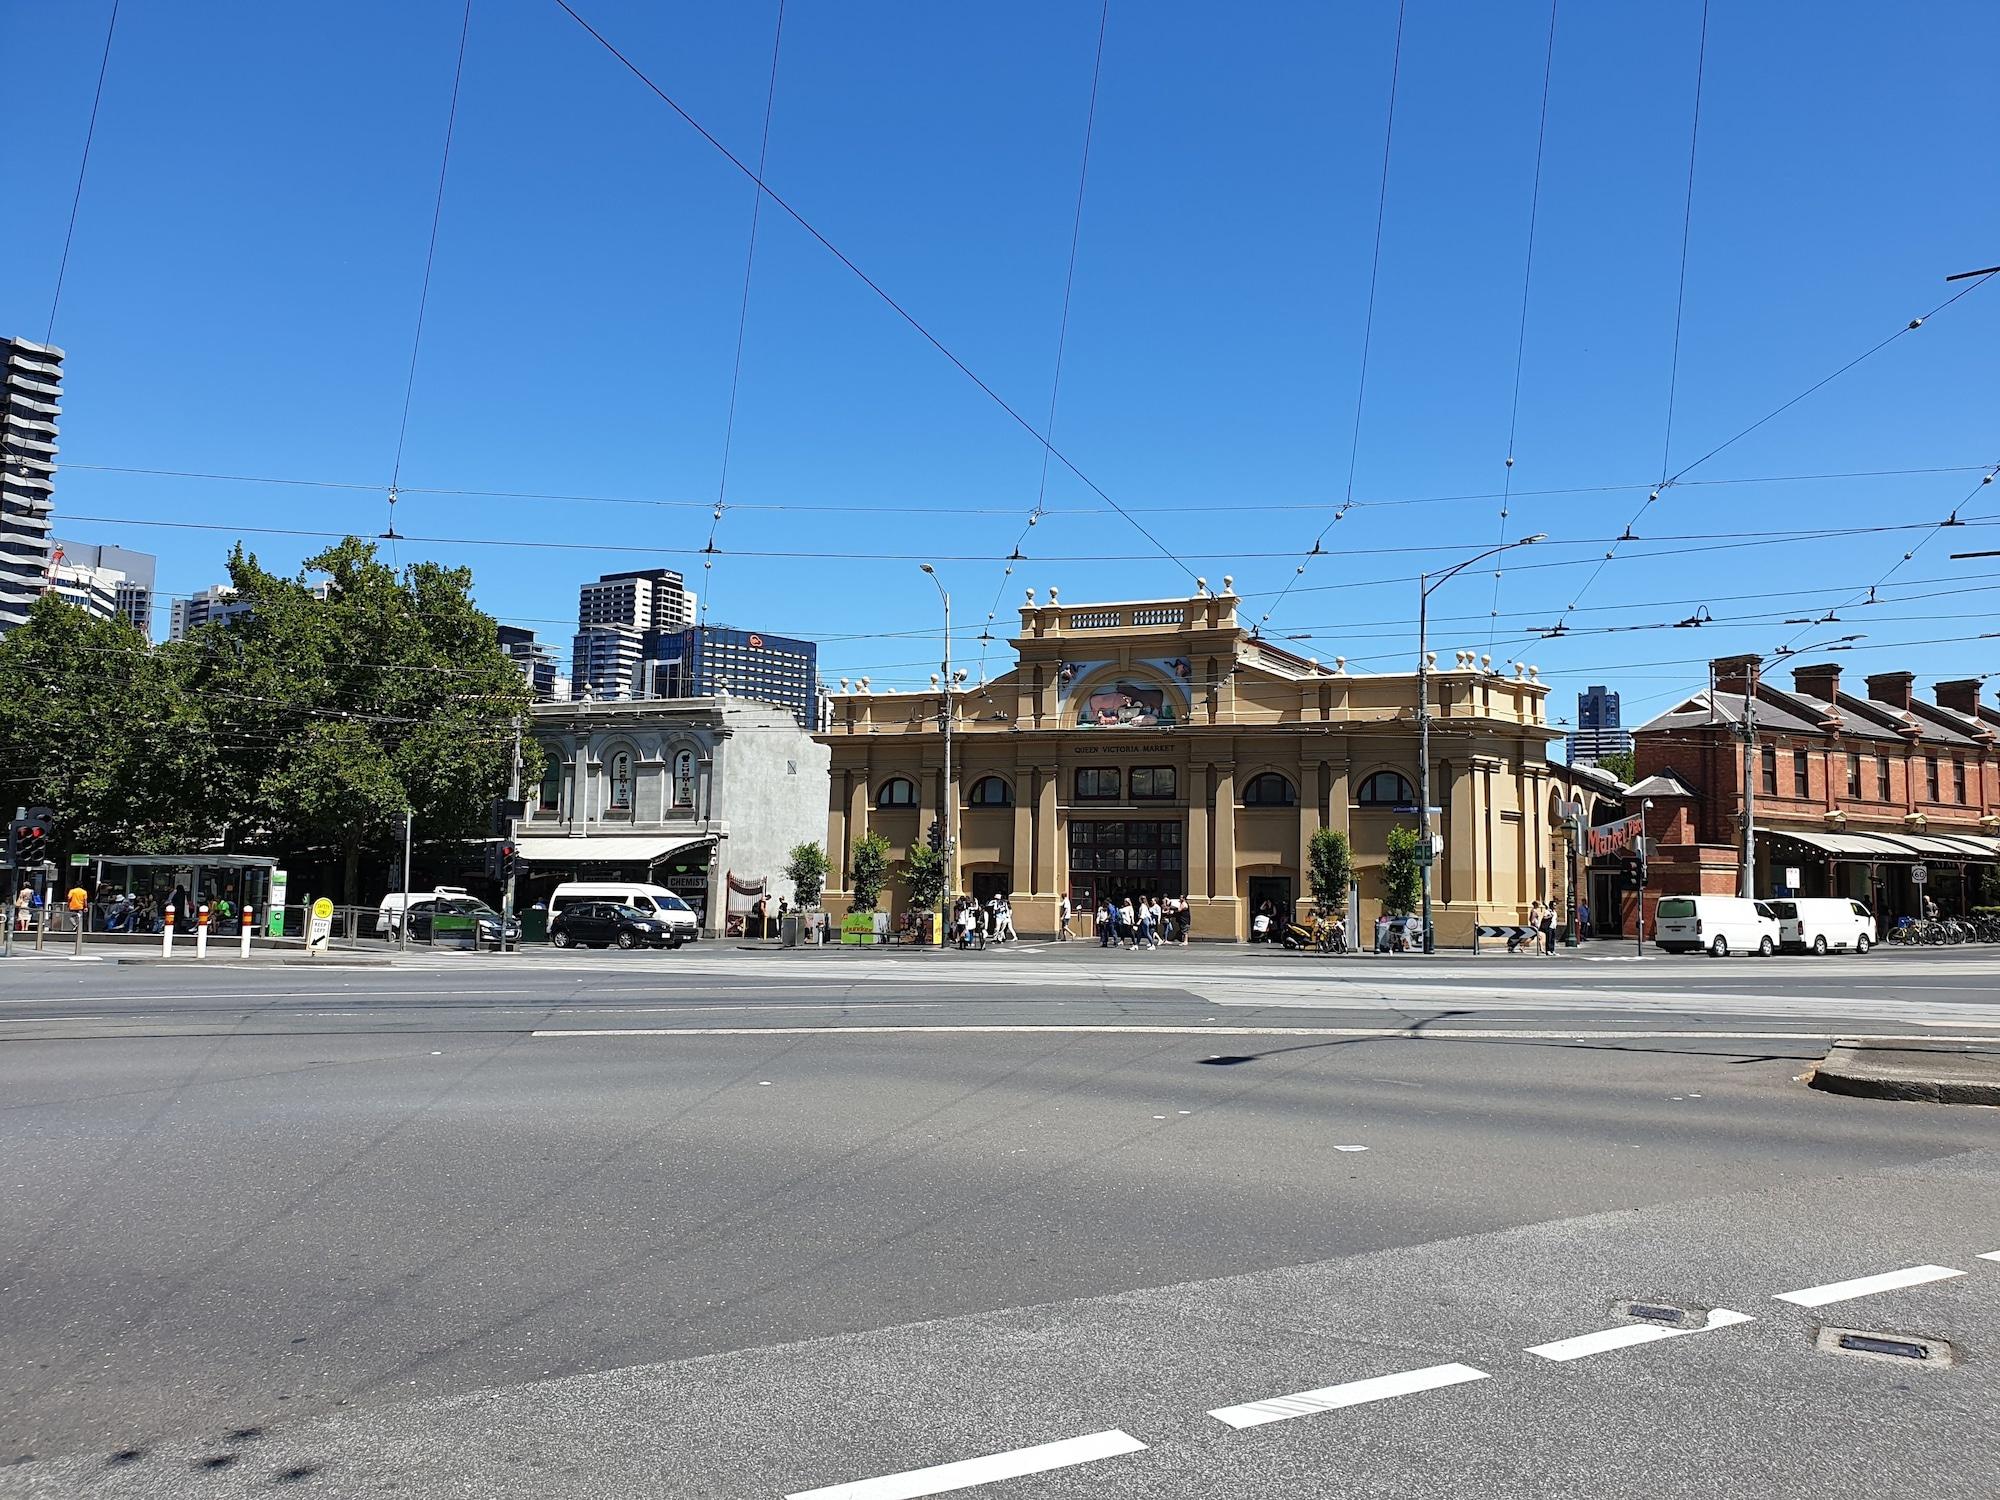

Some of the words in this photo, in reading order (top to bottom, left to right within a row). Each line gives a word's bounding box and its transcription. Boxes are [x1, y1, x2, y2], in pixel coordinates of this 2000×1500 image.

[1143, 745, 1175, 753] MARKET
[619, 764, 628, 798] CHEMIST
[681, 763, 690, 797] CHEMIST
[1588, 825, 1627, 858] Market
[670, 878, 704, 887] CHEMIST
